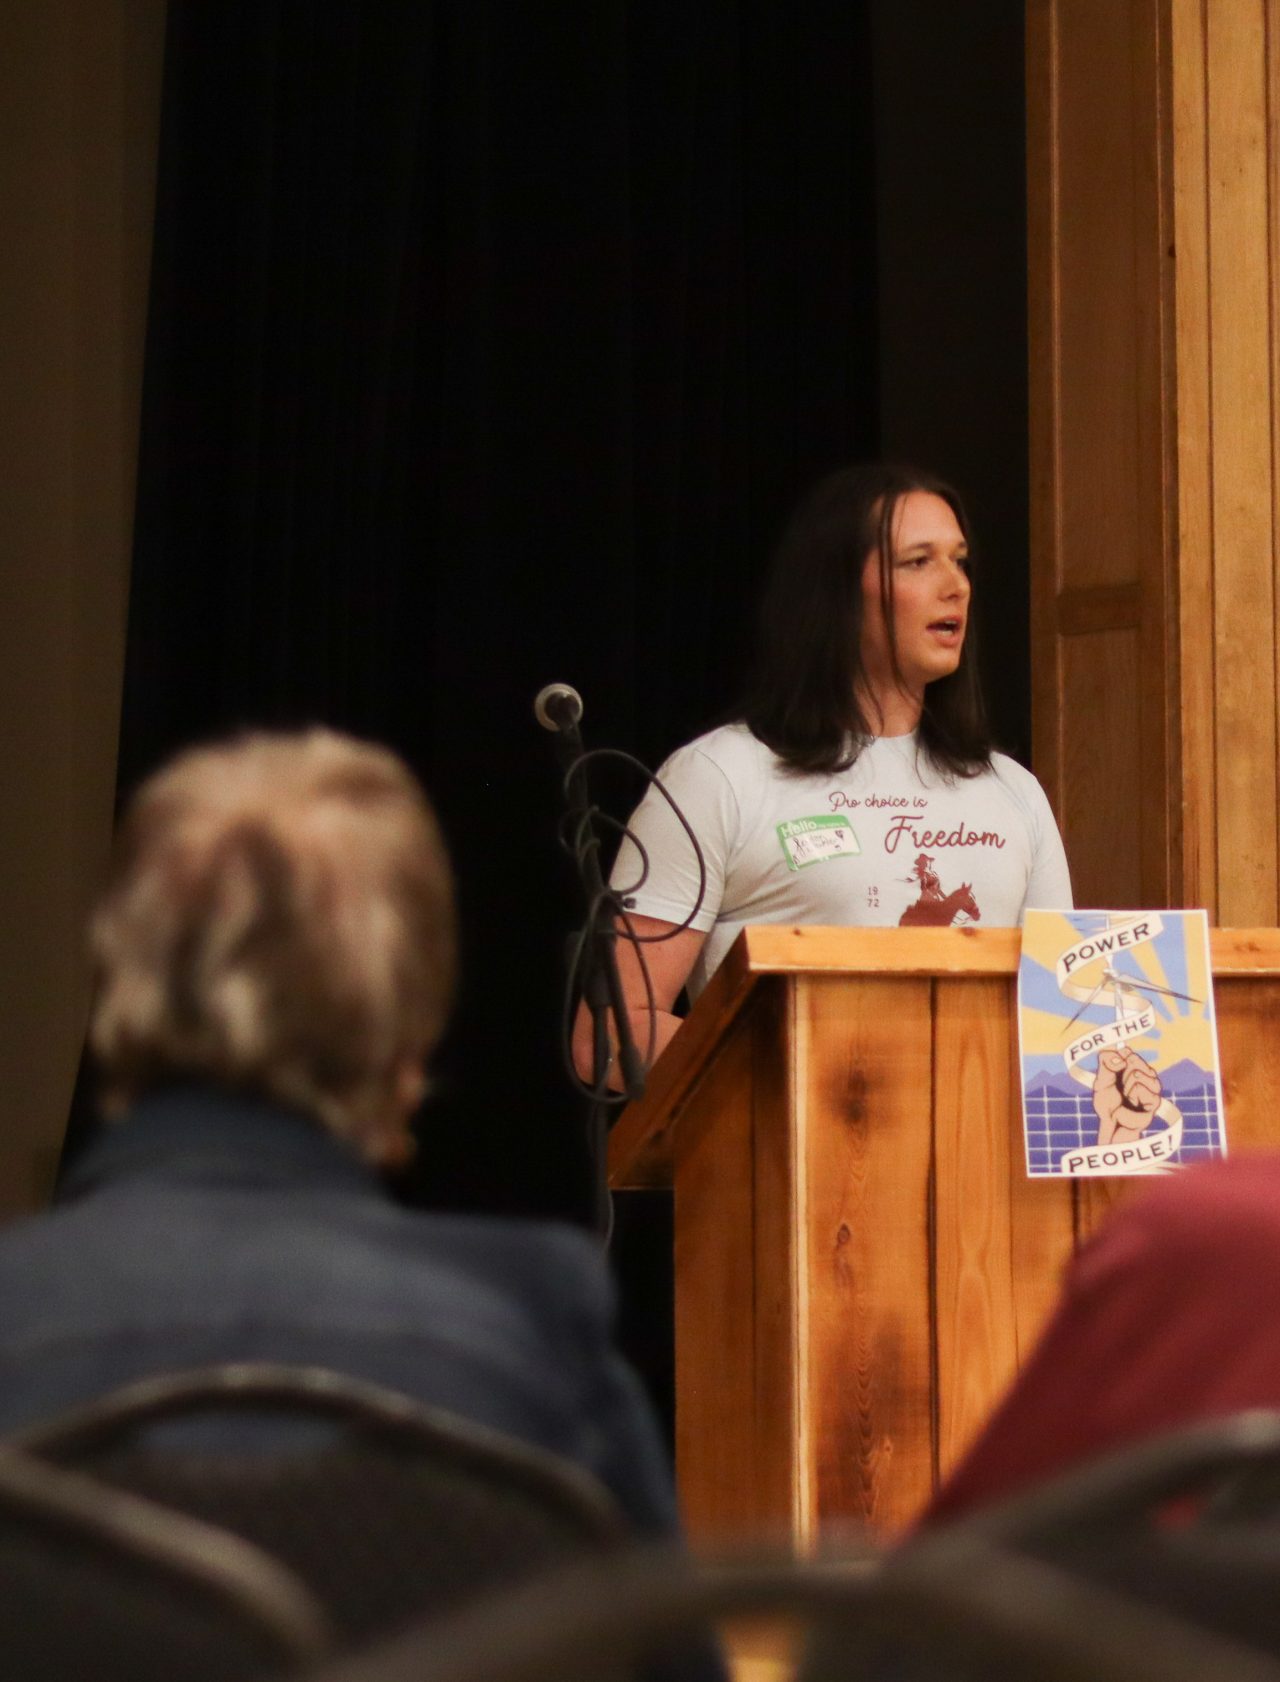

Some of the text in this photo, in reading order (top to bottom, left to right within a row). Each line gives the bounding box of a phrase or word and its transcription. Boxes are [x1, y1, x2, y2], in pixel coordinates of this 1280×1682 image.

[829, 791, 928, 812] Pro choice is
[884, 815, 1006, 854] Freedom
[1062, 922, 1150, 973] POWER
[1069, 1014, 1151, 1061] FOR THE
[1068, 1135, 1174, 1173] PEOPLE!
